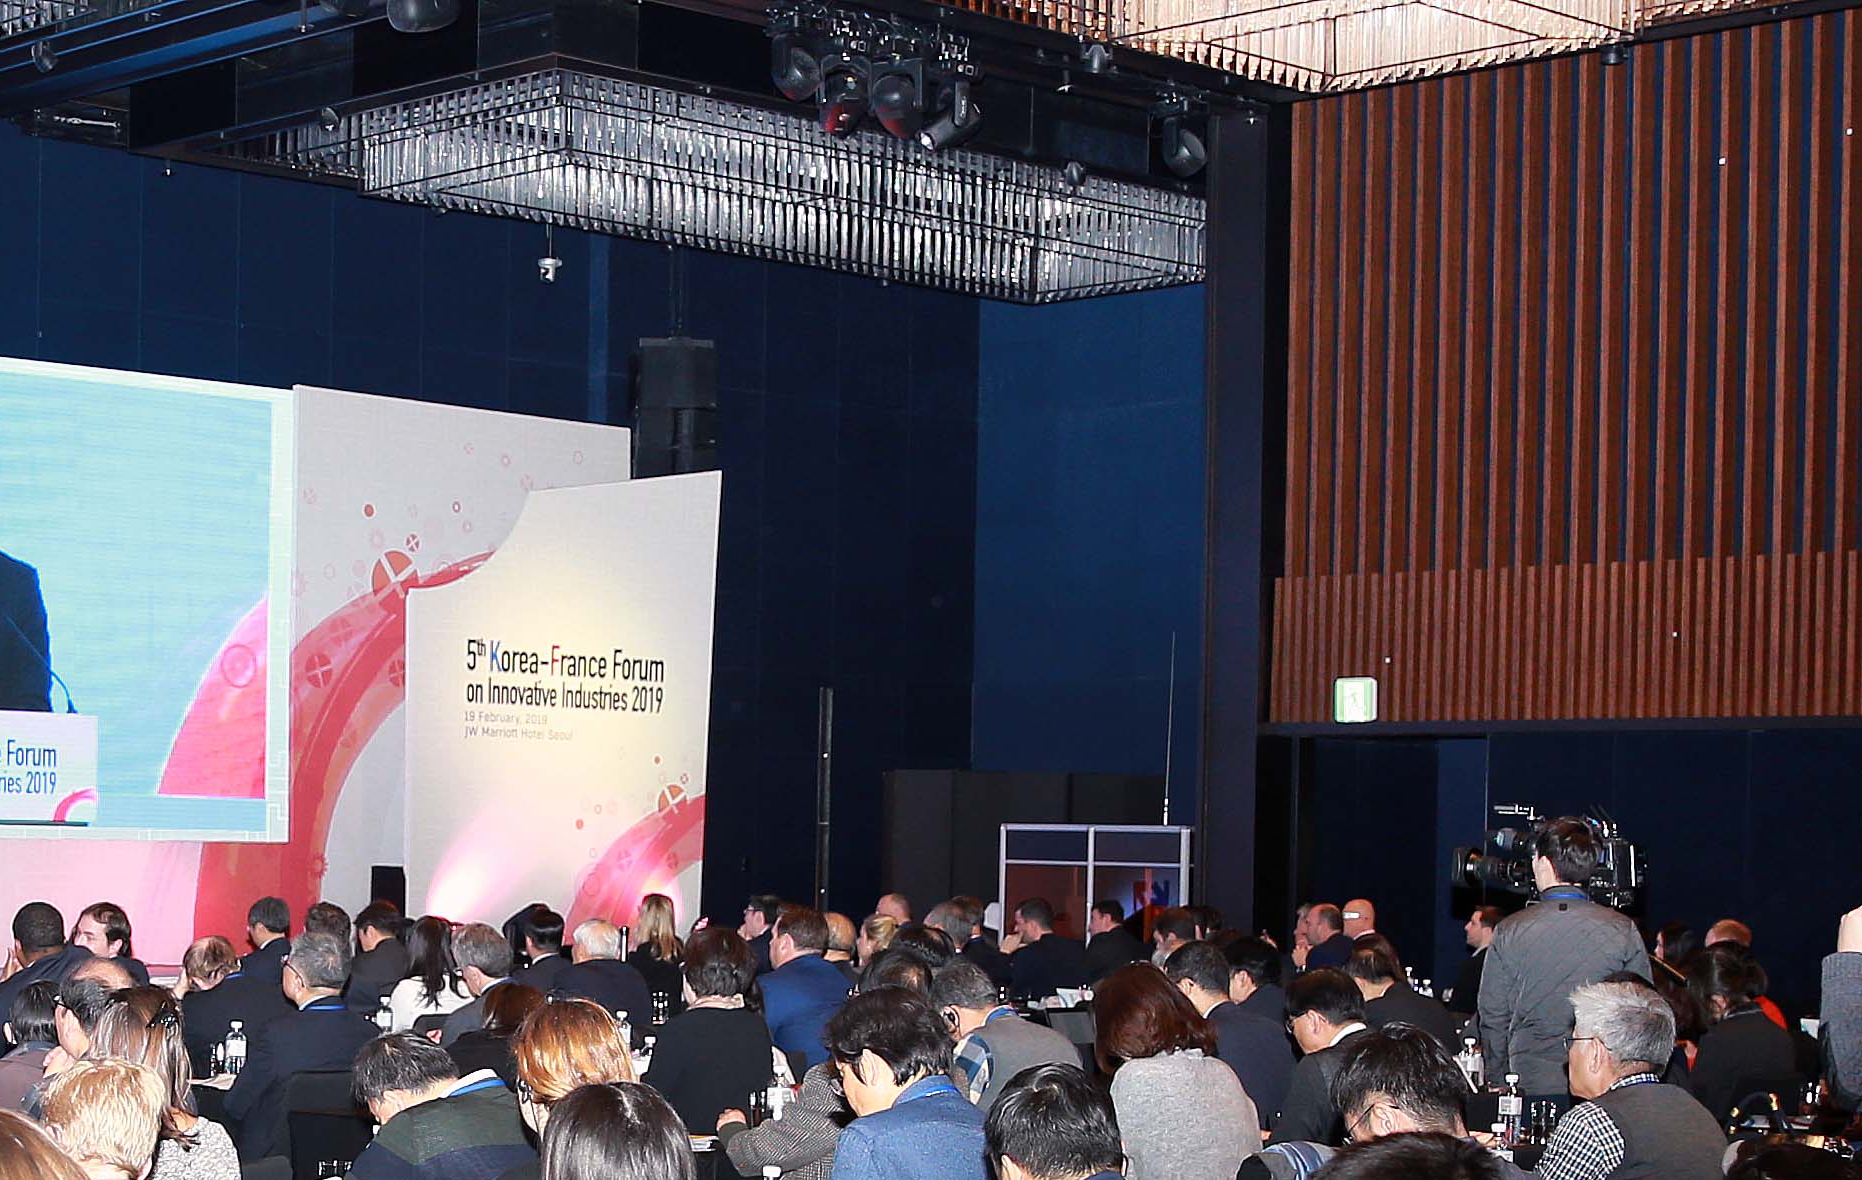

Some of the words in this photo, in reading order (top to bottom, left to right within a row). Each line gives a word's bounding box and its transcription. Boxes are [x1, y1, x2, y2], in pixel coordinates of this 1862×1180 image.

[466, 638, 486, 671] 5th
[489, 639, 606, 678] Korea-France
[613, 648, 664, 683] Forum
[466, 681, 483, 703] on
[488, 677, 557, 707] Innovative
[562, 680, 627, 712] Industries
[632, 685, 663, 713] 2019
[7, 739, 57, 768] Forum
[26, 770, 56, 794] 2019
